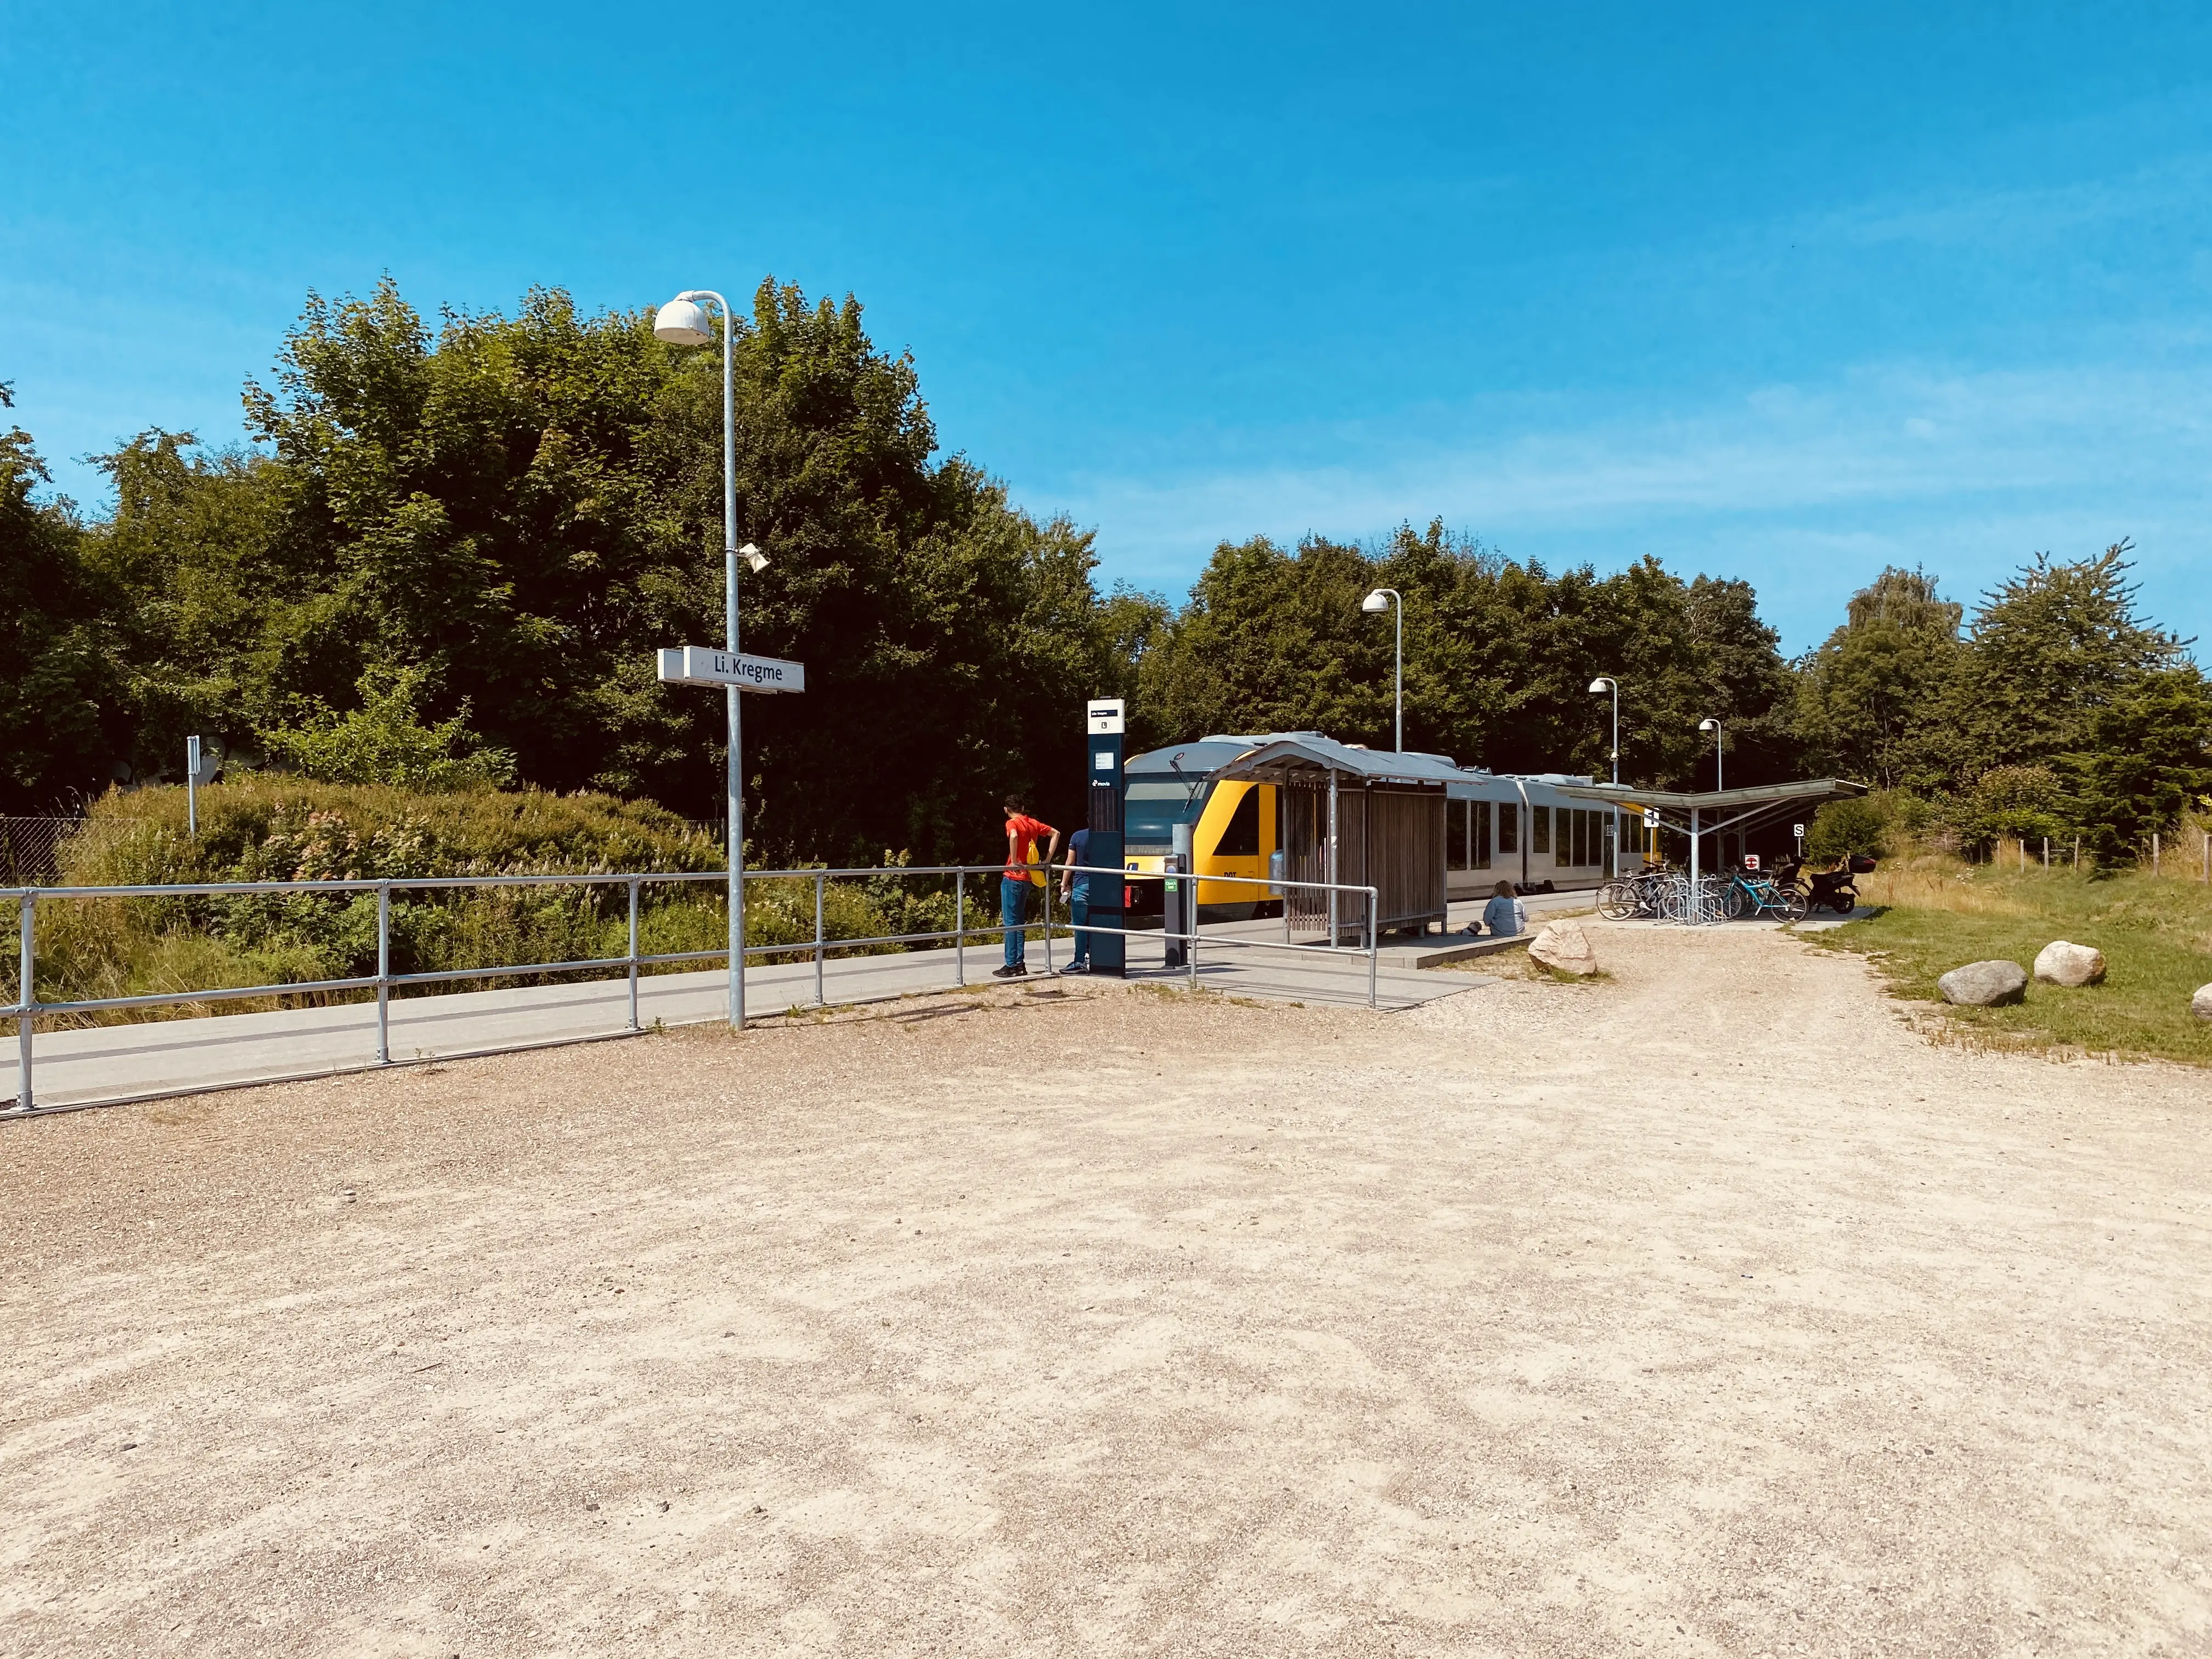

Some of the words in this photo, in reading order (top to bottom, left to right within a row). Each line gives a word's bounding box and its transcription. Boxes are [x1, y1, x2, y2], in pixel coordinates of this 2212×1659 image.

[715, 656, 729, 674] Li.
[732, 658, 783, 684] Kregme
[1648, 810, 1655, 825] 1
[1795, 826, 1803, 835] S
